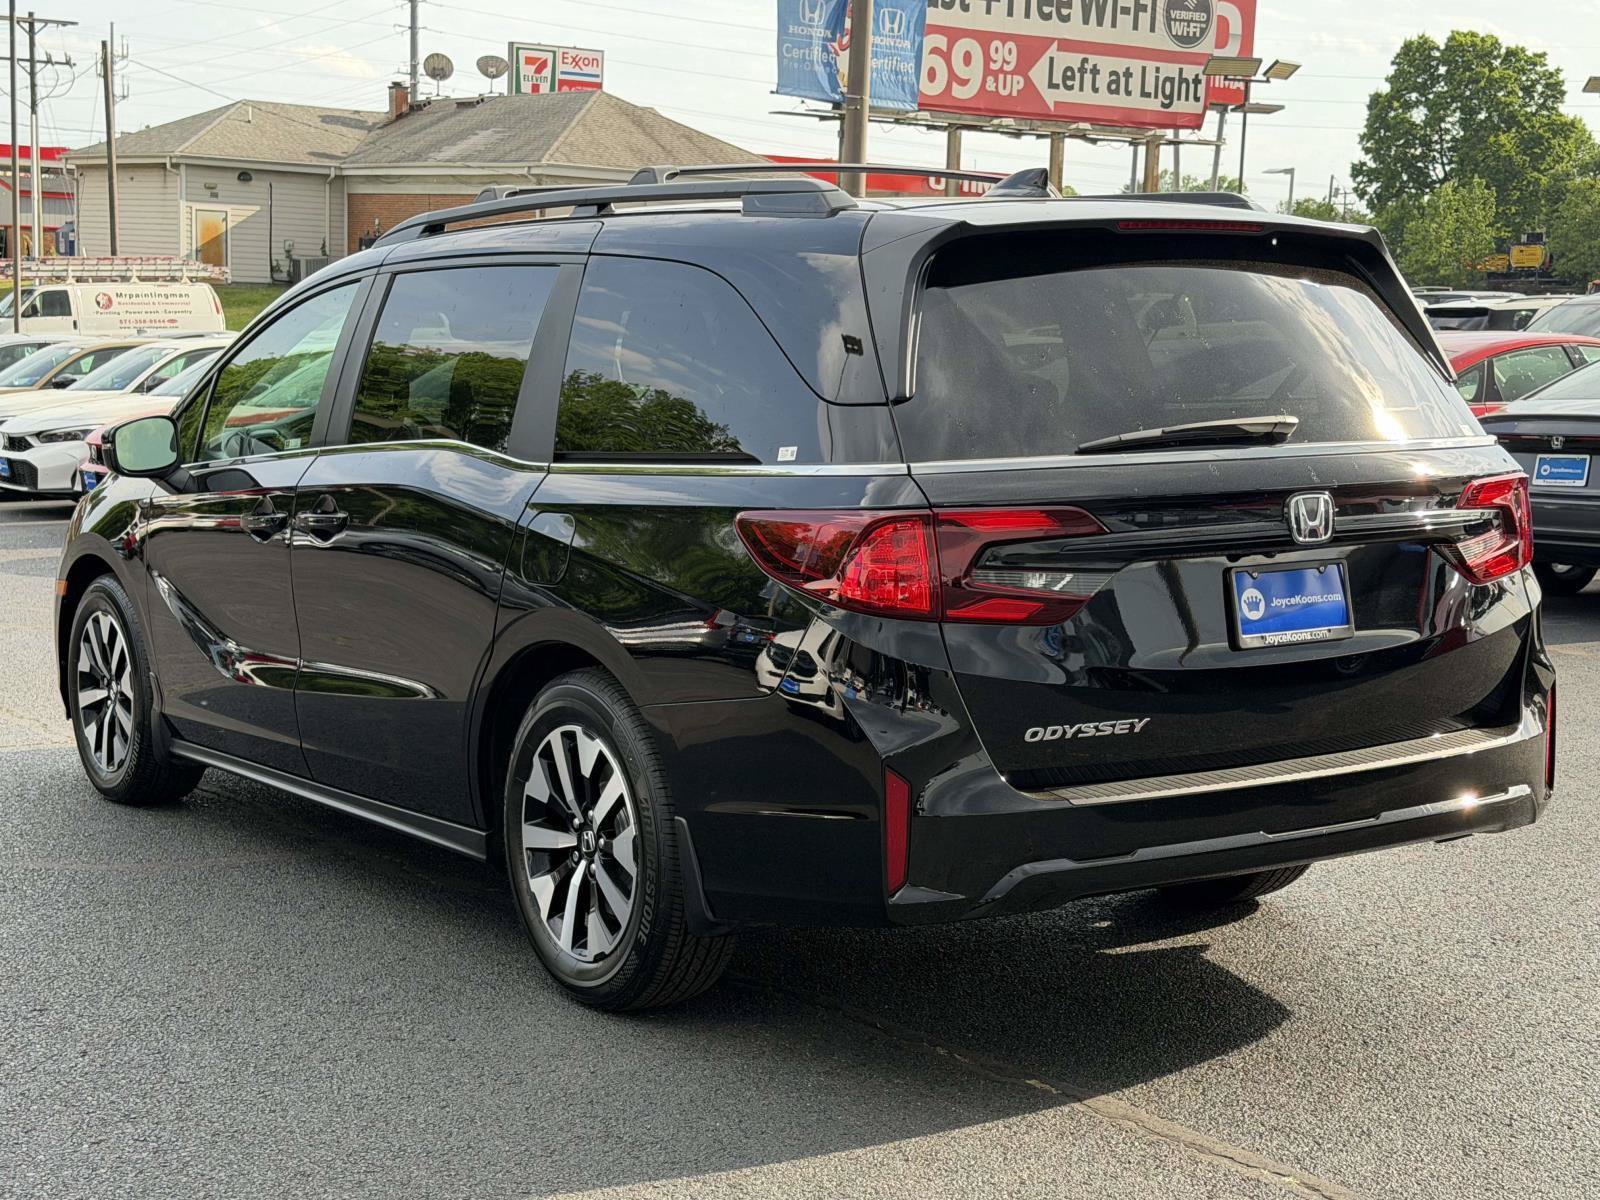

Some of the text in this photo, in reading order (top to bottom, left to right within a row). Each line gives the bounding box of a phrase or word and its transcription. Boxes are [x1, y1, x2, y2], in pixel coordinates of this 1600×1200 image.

[1170, 9, 1207, 22] VERIFIED
[788, 24, 832, 38] HONDA
[561, 52, 599, 71] Exxon
[871, 57, 915, 73] ertified
[989, 40, 1017, 72] 99
[919, 33, 984, 100] 69
[1047, 56, 1100, 94] Left
[1106, 66, 1133, 97] at
[1139, 66, 1203, 110] Light
[1270, 592, 1342, 609] JoyceKoons.com
[1263, 629, 1330, 646] JoyceKoons.com
[1024, 717, 1151, 742] ODYSSEY
